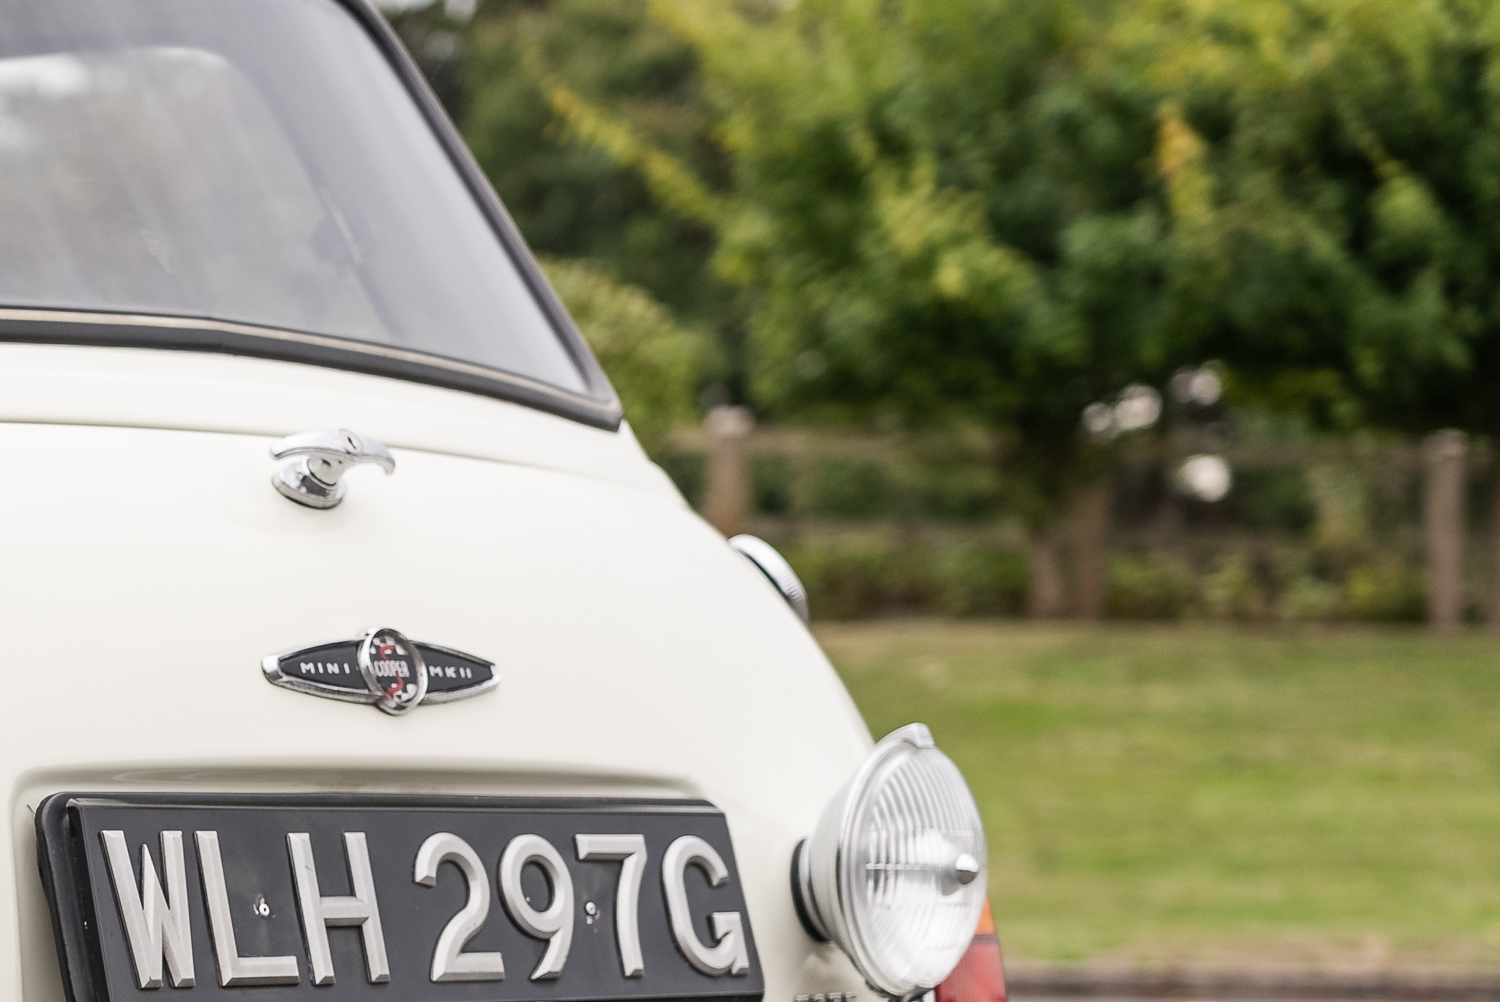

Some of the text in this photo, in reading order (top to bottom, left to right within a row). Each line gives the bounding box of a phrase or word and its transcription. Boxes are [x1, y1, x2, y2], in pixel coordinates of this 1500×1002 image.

[300, 661, 350, 675] MINI
[373, 660, 410, 678] COOPER
[101, 829, 749, 989] WLH 297G
